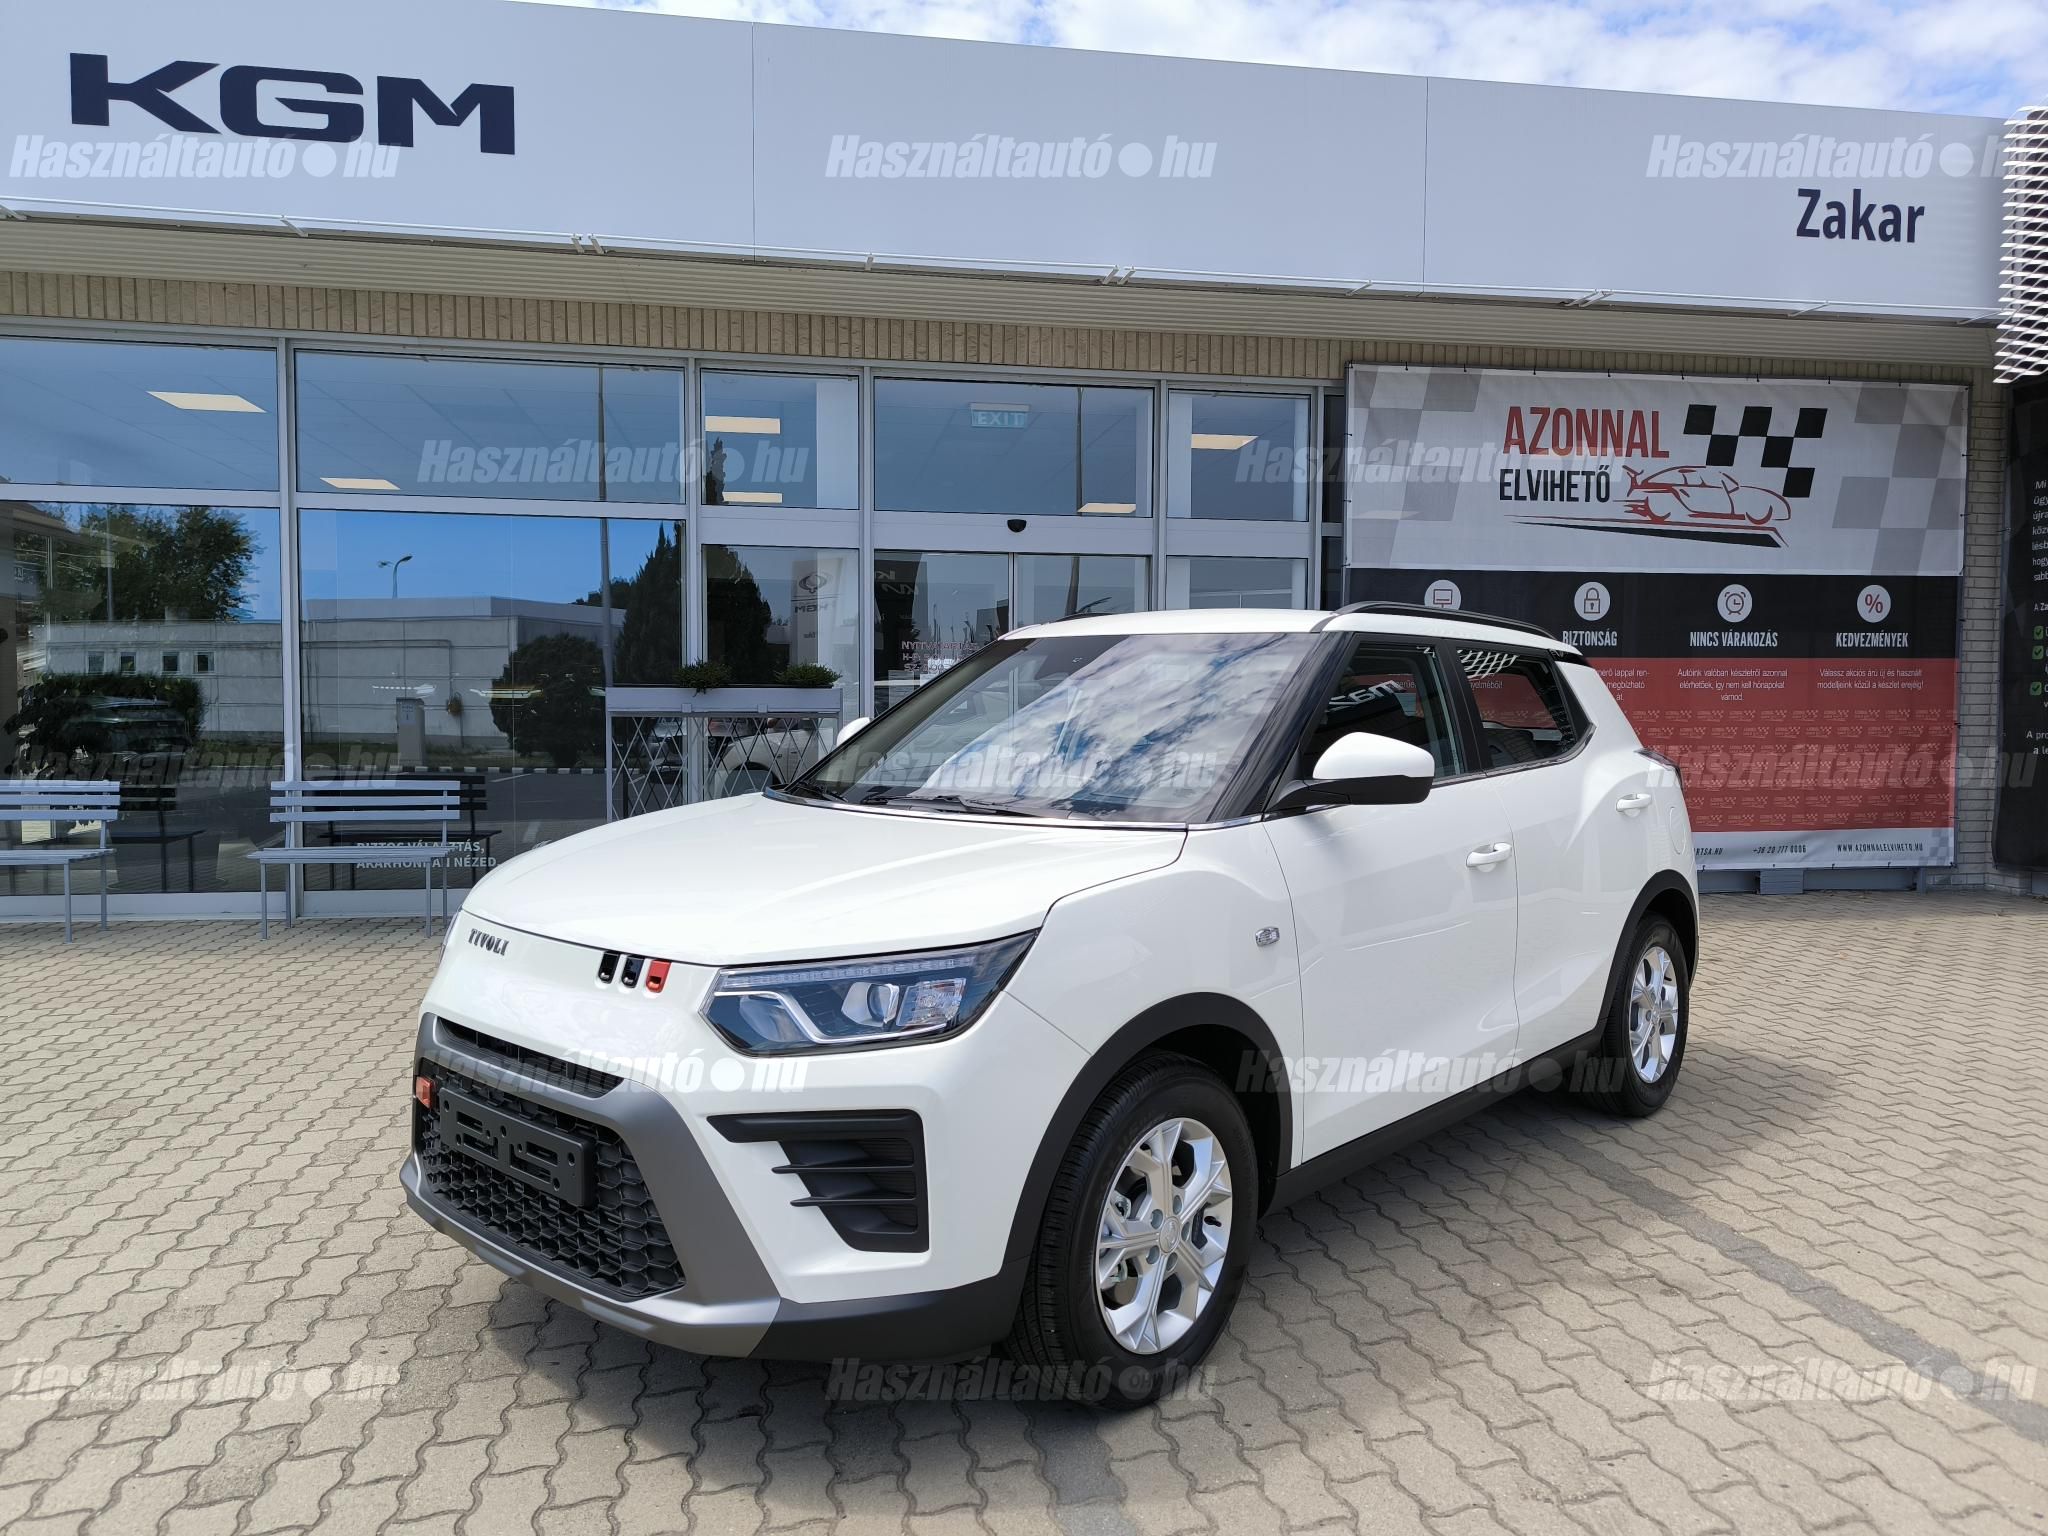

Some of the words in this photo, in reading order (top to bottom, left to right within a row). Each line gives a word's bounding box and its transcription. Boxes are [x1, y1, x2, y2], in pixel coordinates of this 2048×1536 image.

[70, 53, 515, 155] KGM
[1796, 188, 1925, 243] Zakar
[977, 411, 1025, 426] EXIT
[1503, 406, 1670, 458] AZONNAL
[1500, 465, 1610, 503] ELVIHETŐ
[1562, 628, 1618, 647] BIZTONSÁG
[1690, 631, 1719, 647] NINCS
[1721, 629, 1778, 647] VÁRAKOZÁS
[1836, 630, 1909, 647] KEDVEZMÉNYEK
[468, 928, 510, 956] TIVOLI
